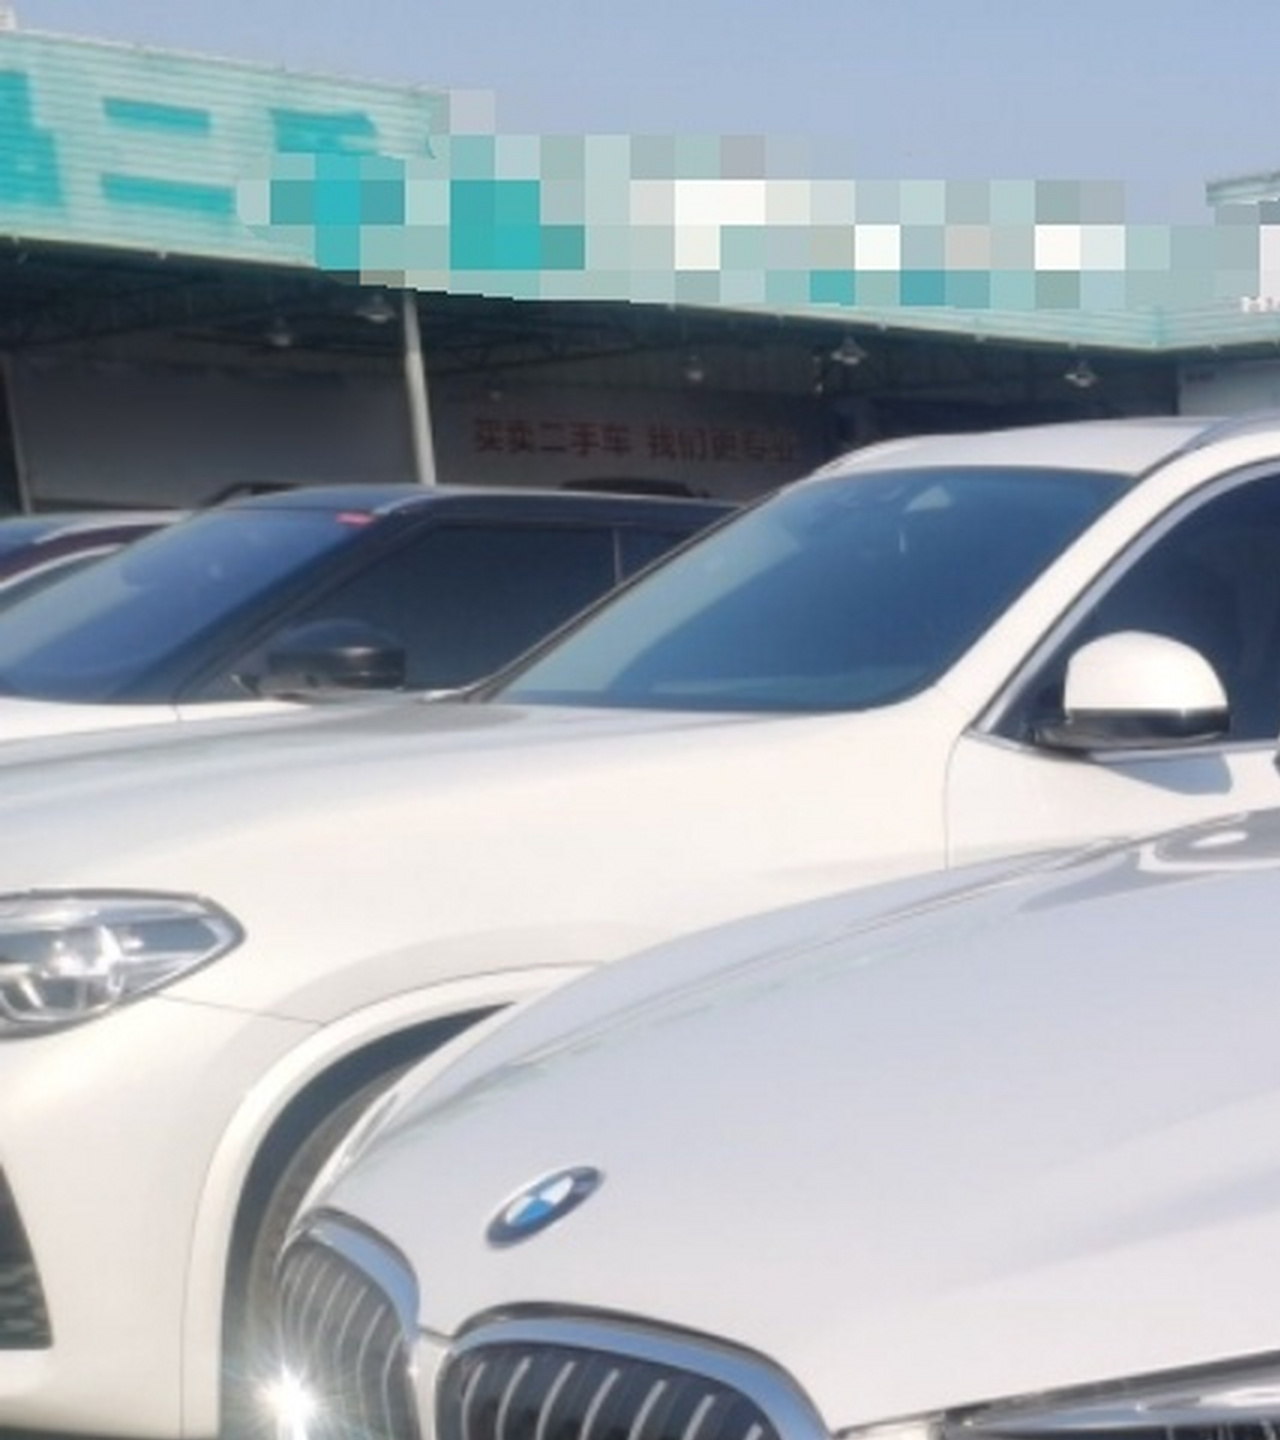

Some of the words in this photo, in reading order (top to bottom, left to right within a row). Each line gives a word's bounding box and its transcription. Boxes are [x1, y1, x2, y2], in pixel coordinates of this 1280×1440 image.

[473, 417, 632, 457] 买卖二手车
[647, 425, 797, 463] 我们更专业
